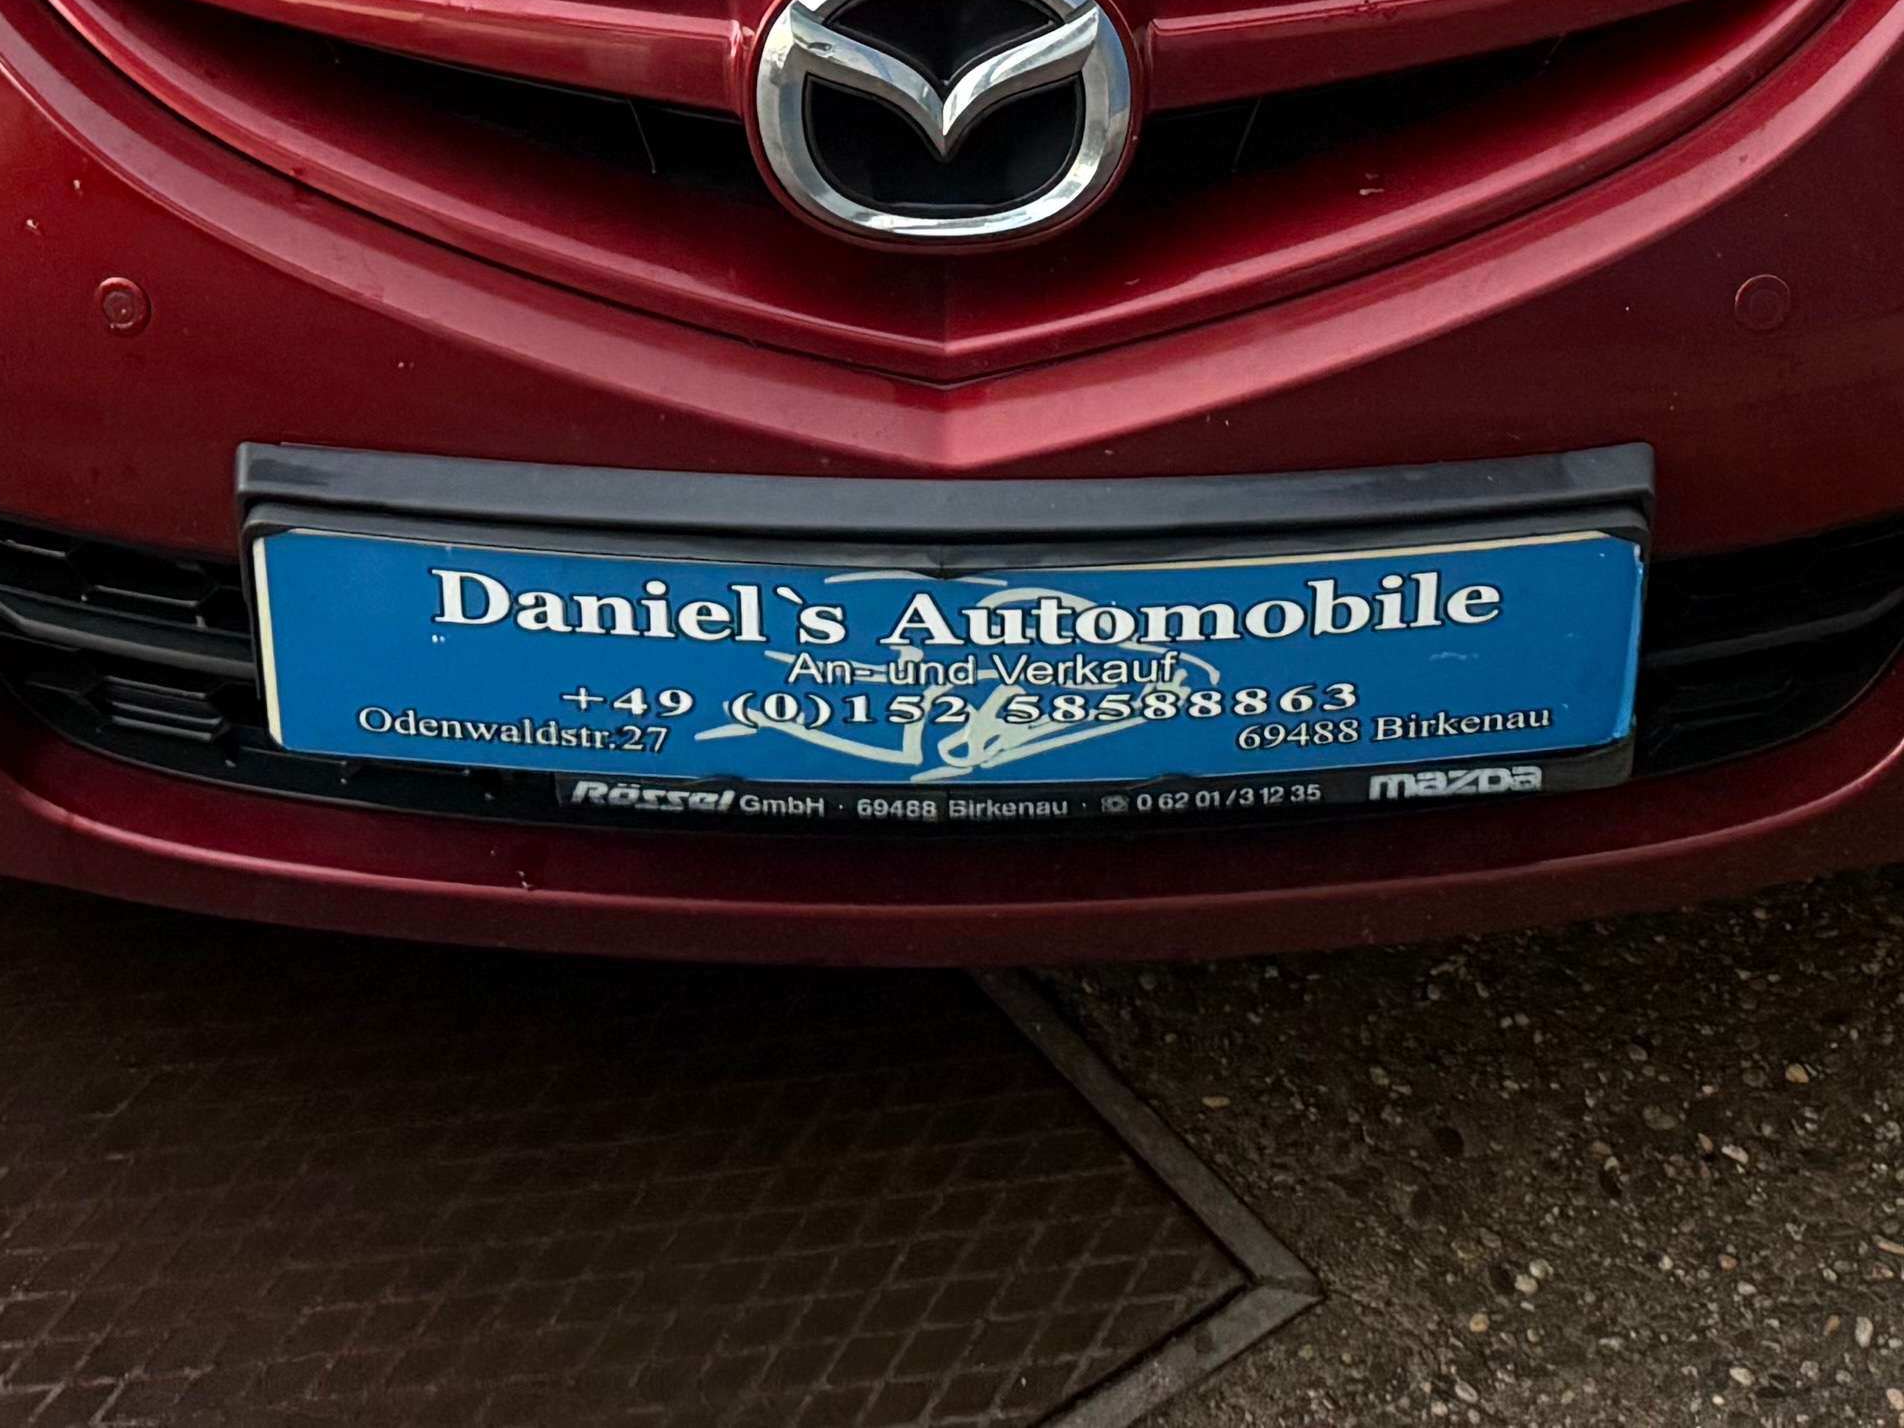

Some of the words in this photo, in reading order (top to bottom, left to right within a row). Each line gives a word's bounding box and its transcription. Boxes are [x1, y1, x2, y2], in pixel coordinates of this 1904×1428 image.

[879, 570, 1502, 646] Automobile
[787, 652, 873, 685] An-
[889, 655, 978, 685] und
[994, 651, 1177, 685] Verkauf
[562, 686, 694, 718] +49
[730, 690, 970, 728] (0)152
[1004, 681, 1358, 724] 58588863
[1237, 719, 1360, 750] 69488
[1372, 708, 1551, 741] Birkenau
[570, 780, 736, 811] Rössel
[739, 795, 824, 817] GmbH
[857, 798, 937, 821] 69488
[949, 799, 1068, 821] Birkenau
